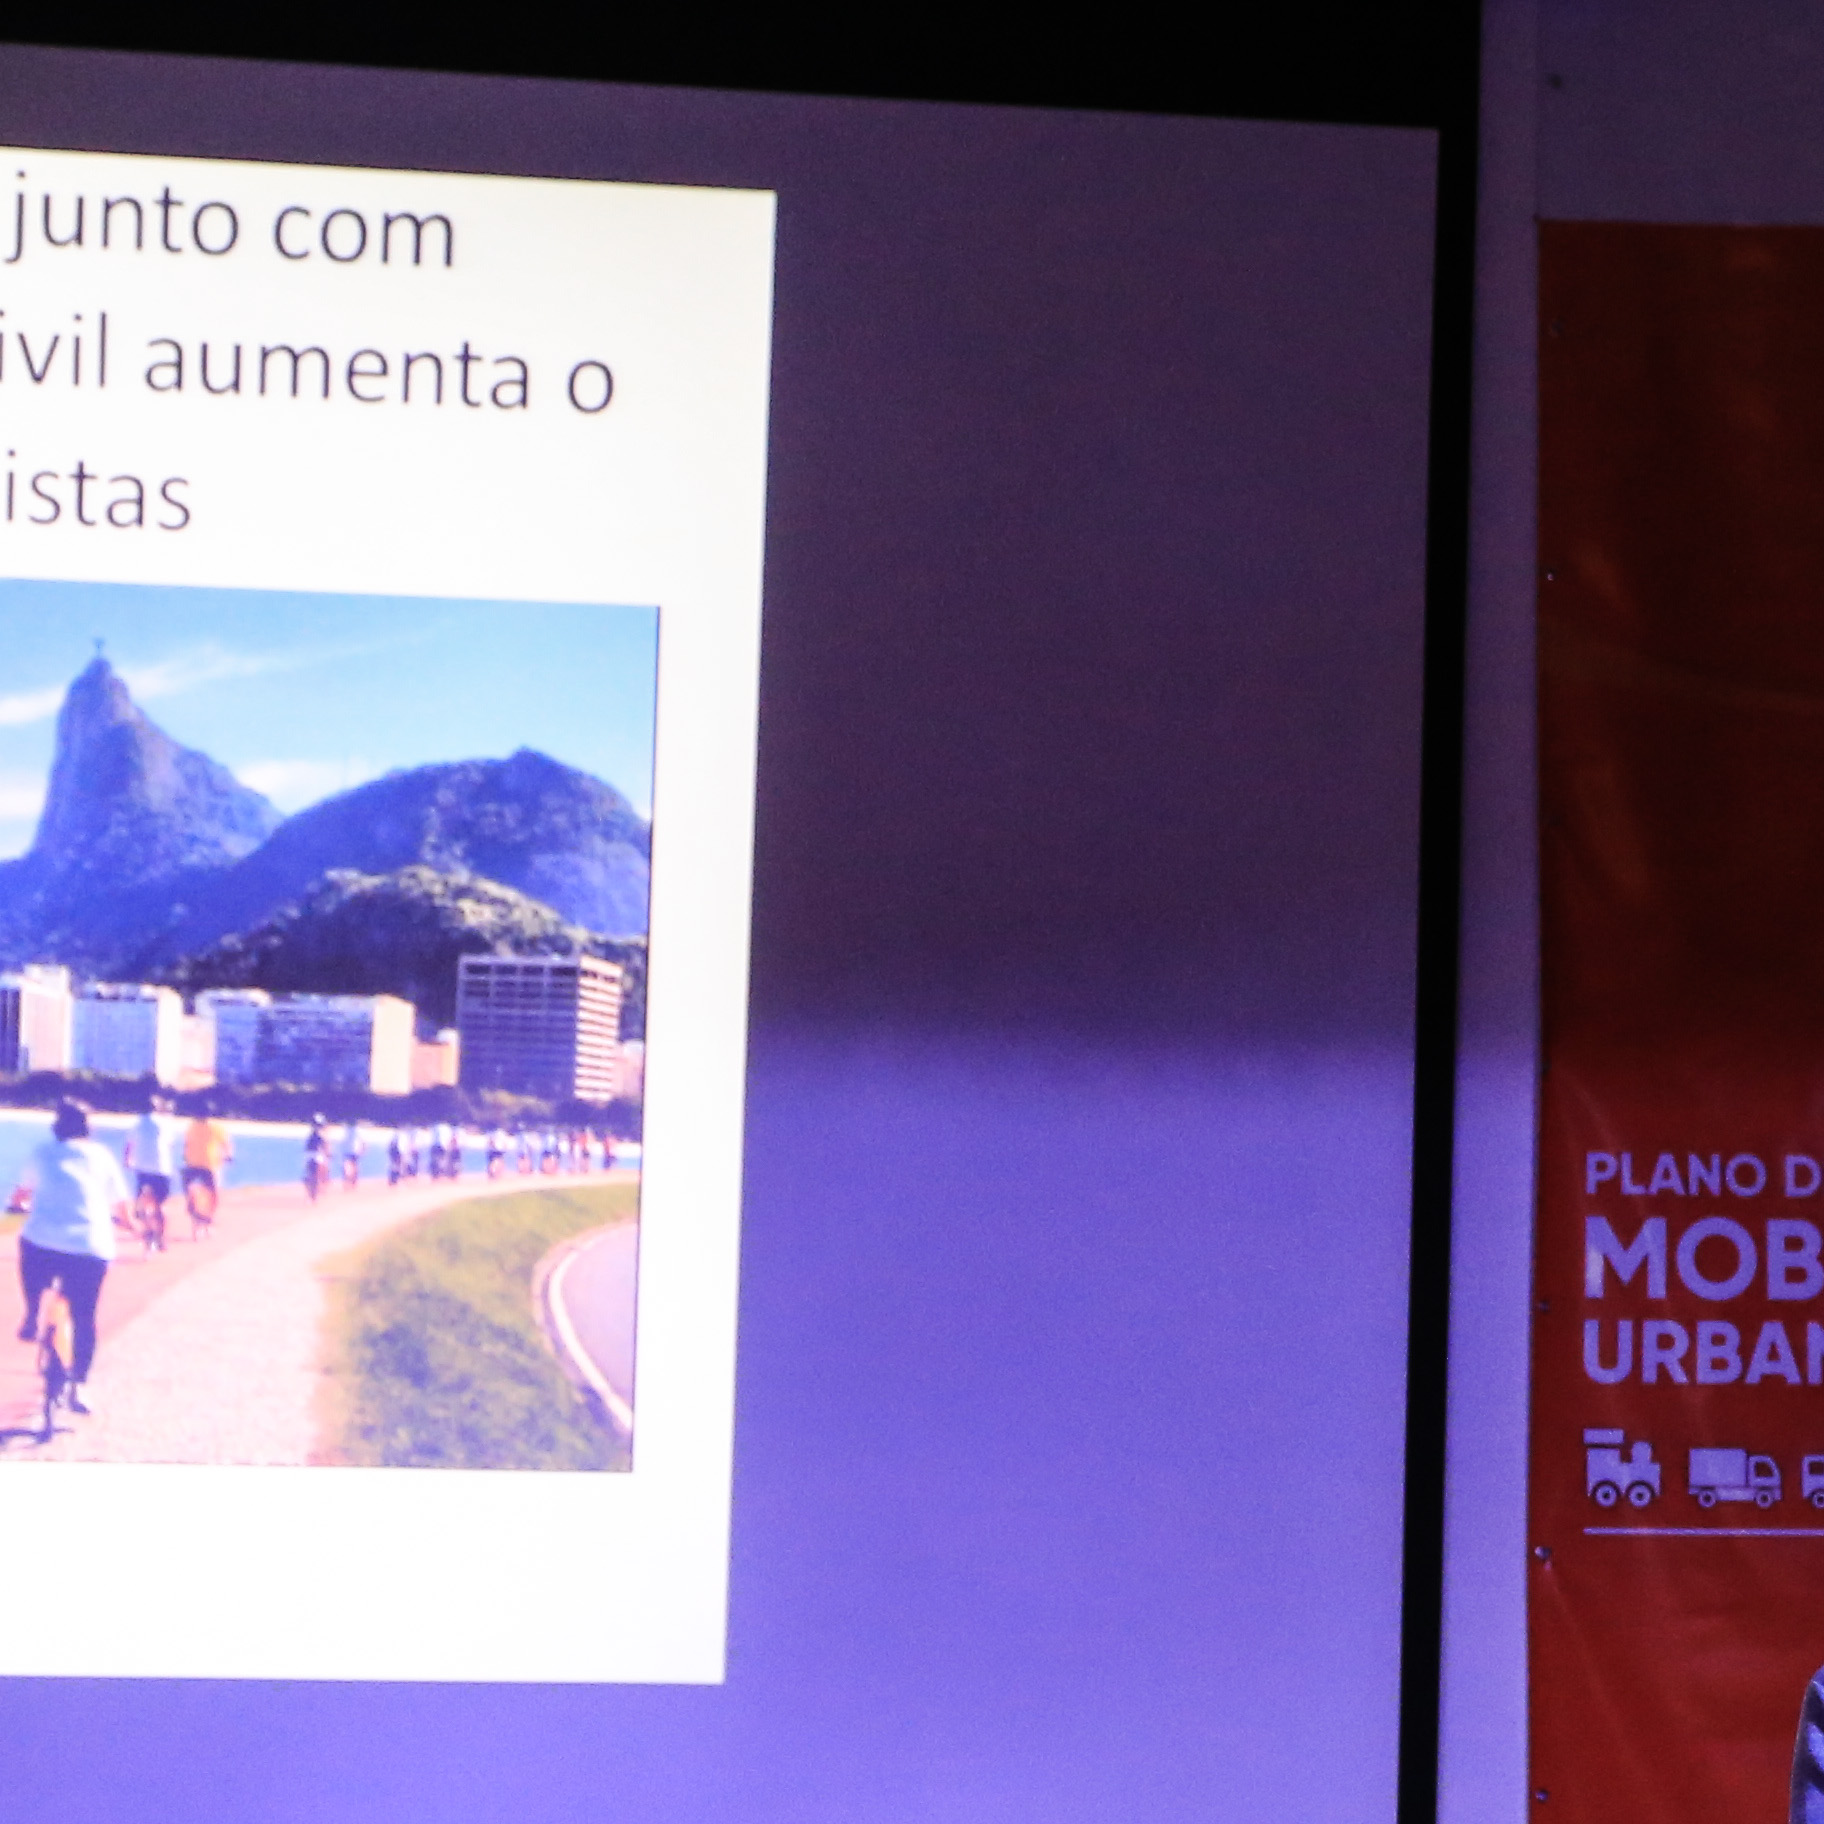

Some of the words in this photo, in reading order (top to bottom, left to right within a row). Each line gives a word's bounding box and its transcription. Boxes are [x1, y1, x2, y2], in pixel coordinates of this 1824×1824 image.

[5, 171, 239, 264] junto
[274, 206, 454, 268] com
[145, 338, 529, 409] aumenta
[567, 360, 614, 414] o
[1586, 1152, 1766, 1196] PLANO
